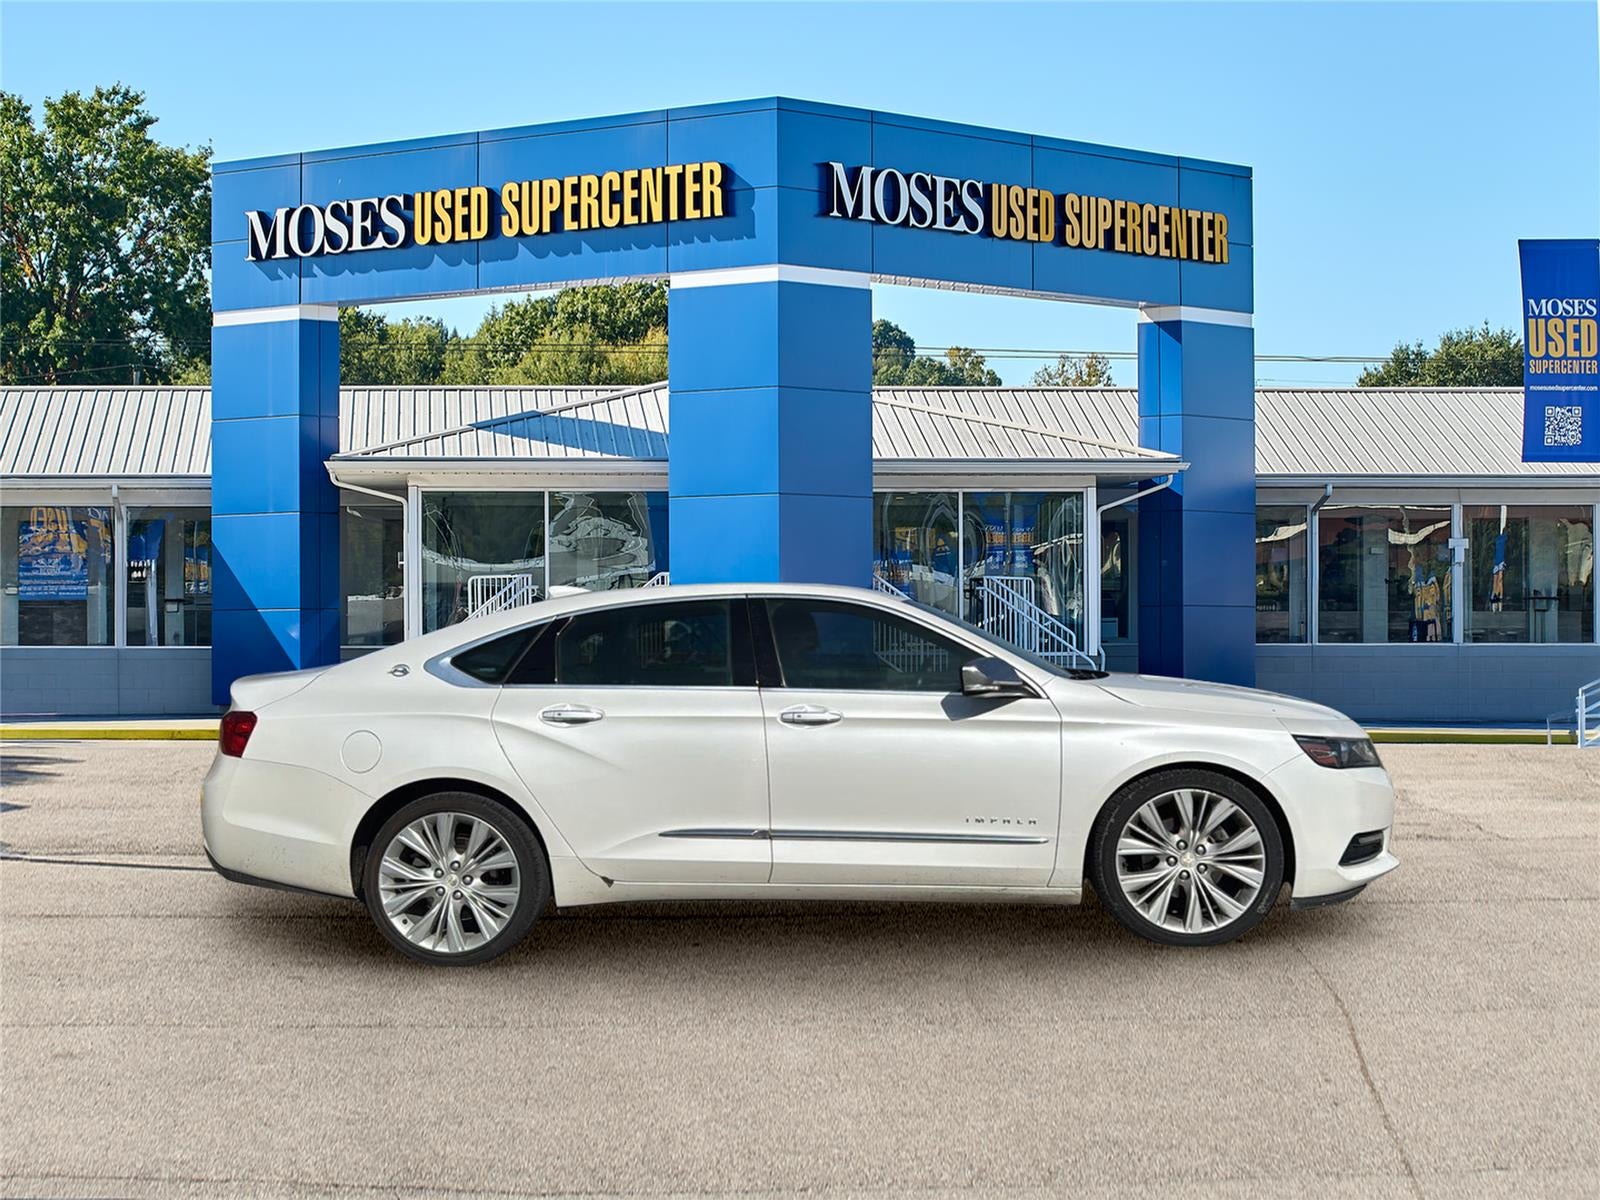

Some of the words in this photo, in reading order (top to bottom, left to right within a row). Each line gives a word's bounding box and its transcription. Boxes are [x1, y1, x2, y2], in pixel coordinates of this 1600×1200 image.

[245, 194, 407, 261] MOSES
[413, 186, 489, 245] USED
[501, 161, 724, 238] SUPERCENTER
[829, 161, 985, 234] MOSES
[991, 183, 1056, 242] USED
[1065, 193, 1229, 264] SUPERCENTER
[1527, 298, 1597, 317] MOSES
[1528, 318, 1598, 358] USED
[1529, 359, 1598, 375] SUPERCENTER
[1530, 384, 1598, 392] mosesusedsupercenter.com
[965, 817, 1037, 825] IMPALA
